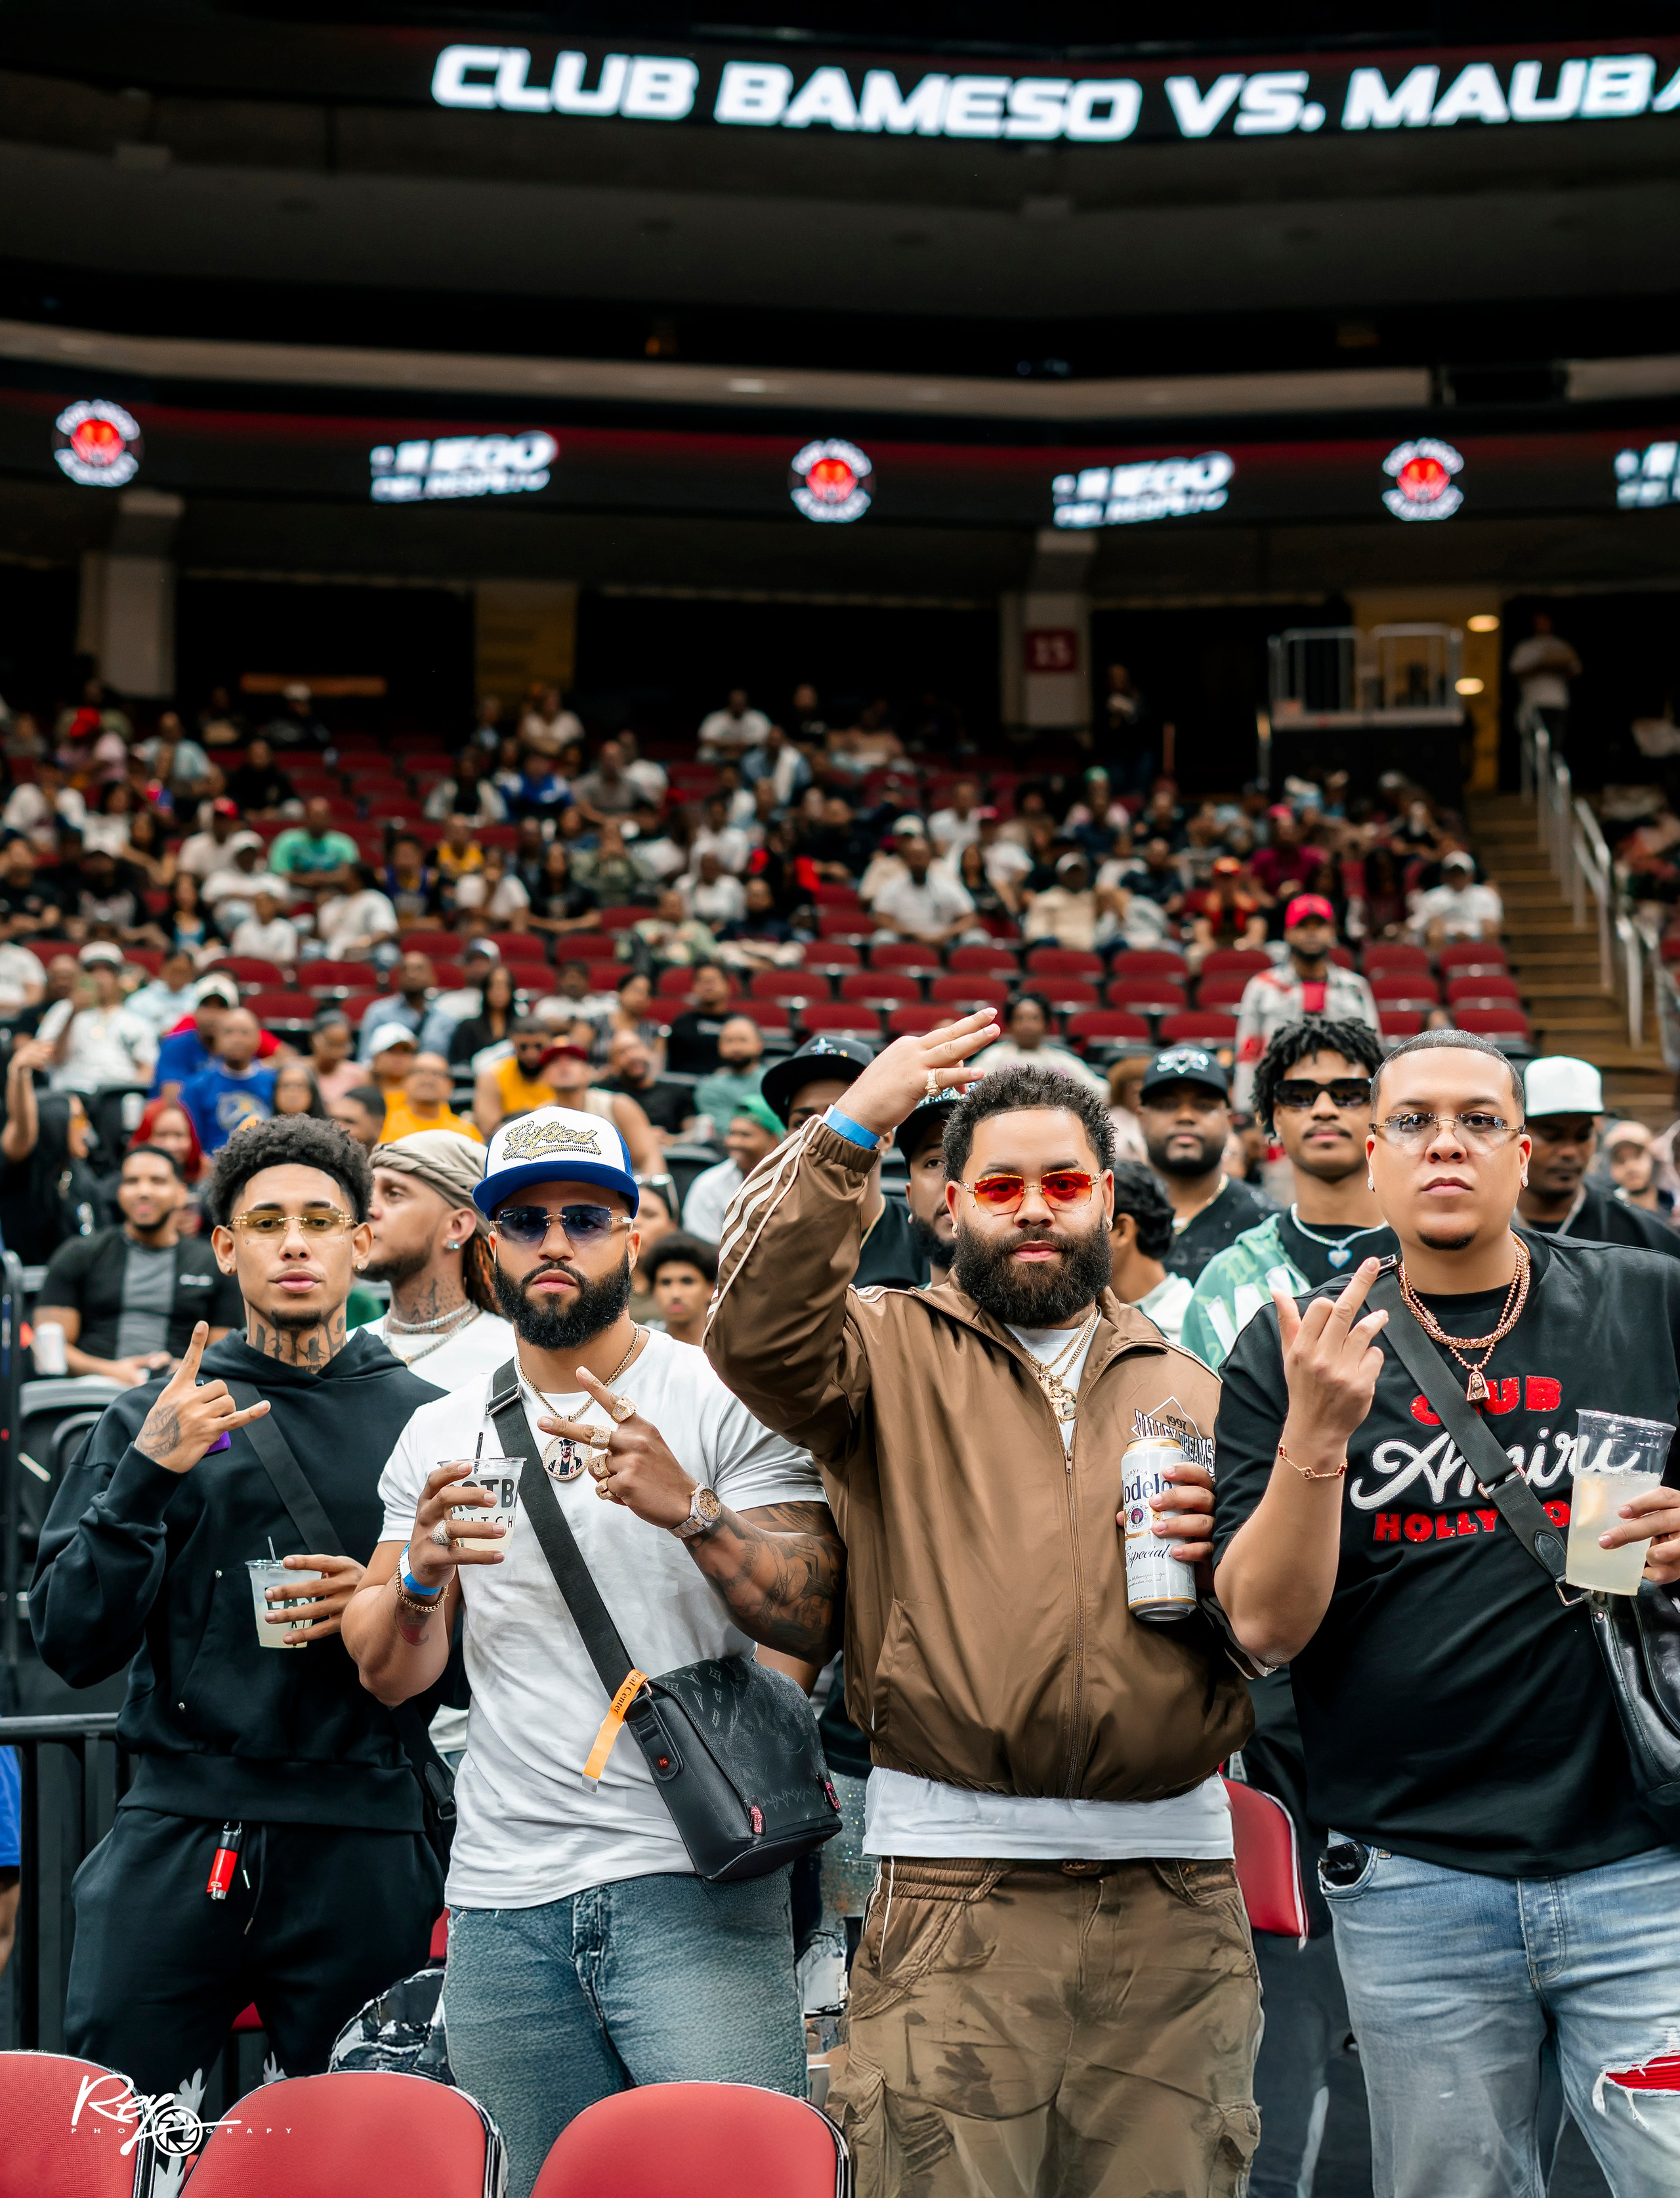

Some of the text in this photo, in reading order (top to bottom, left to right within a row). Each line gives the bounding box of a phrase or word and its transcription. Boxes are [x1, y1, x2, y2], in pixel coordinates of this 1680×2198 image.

[432, 45, 698, 119] CLUB
[715, 62, 1142, 140] BAMESO
[1166, 72, 1325, 137] VS.
[1410, 1374, 1563, 1427] CUB
[1122, 1473, 1173, 1505] odelo
[614, 1687, 632, 1715] Center
